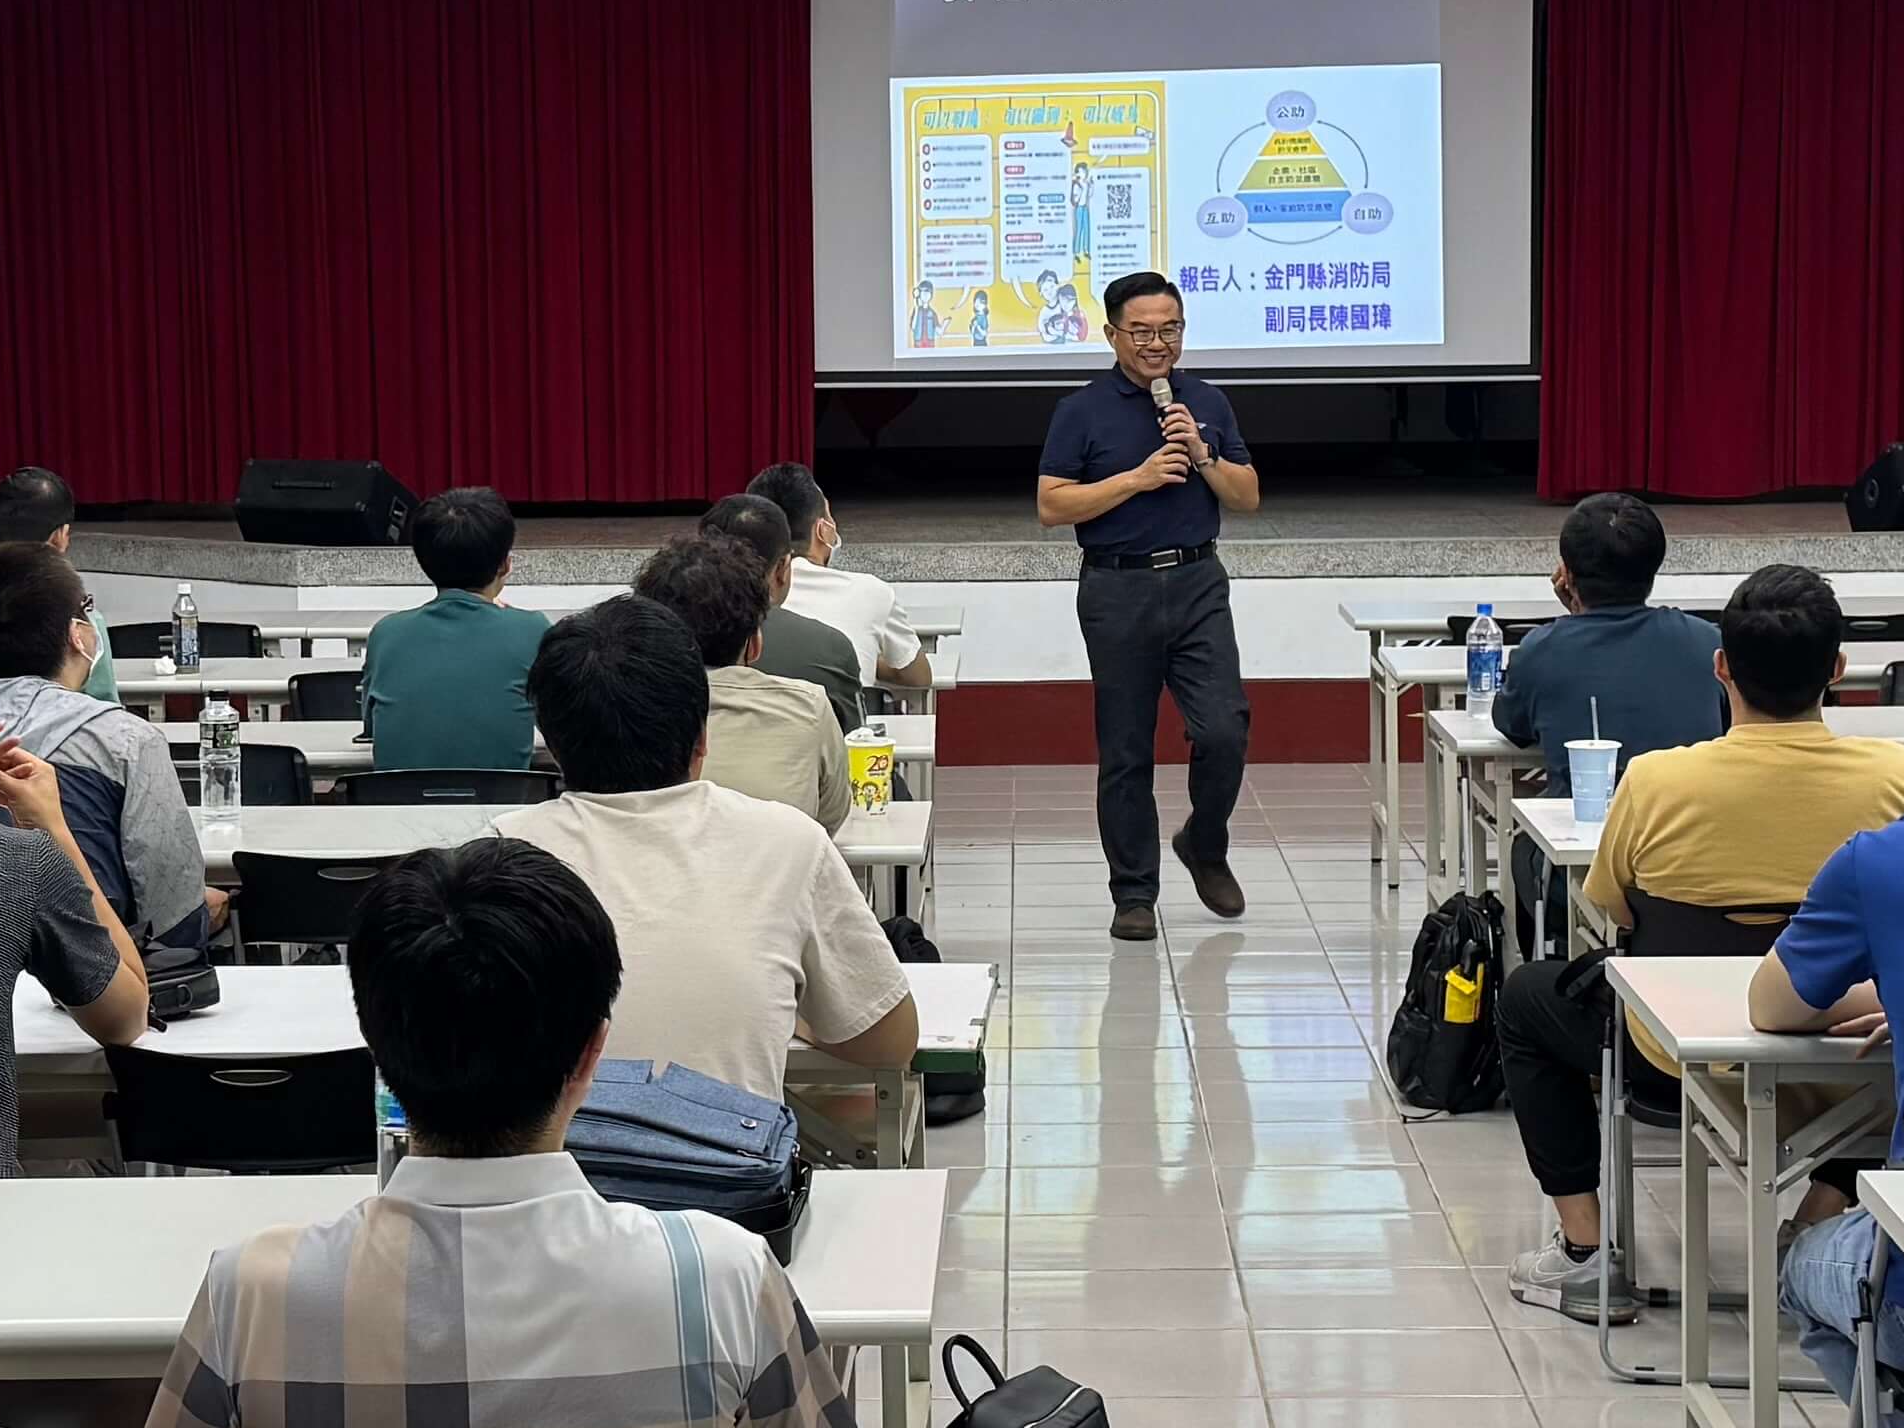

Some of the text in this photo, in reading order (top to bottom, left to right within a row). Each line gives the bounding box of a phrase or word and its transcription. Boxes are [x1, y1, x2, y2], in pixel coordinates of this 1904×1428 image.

[1277, 105, 1305, 119] 公助
[1205, 211, 1236, 225] 互助
[1353, 207, 1382, 221] 自助
